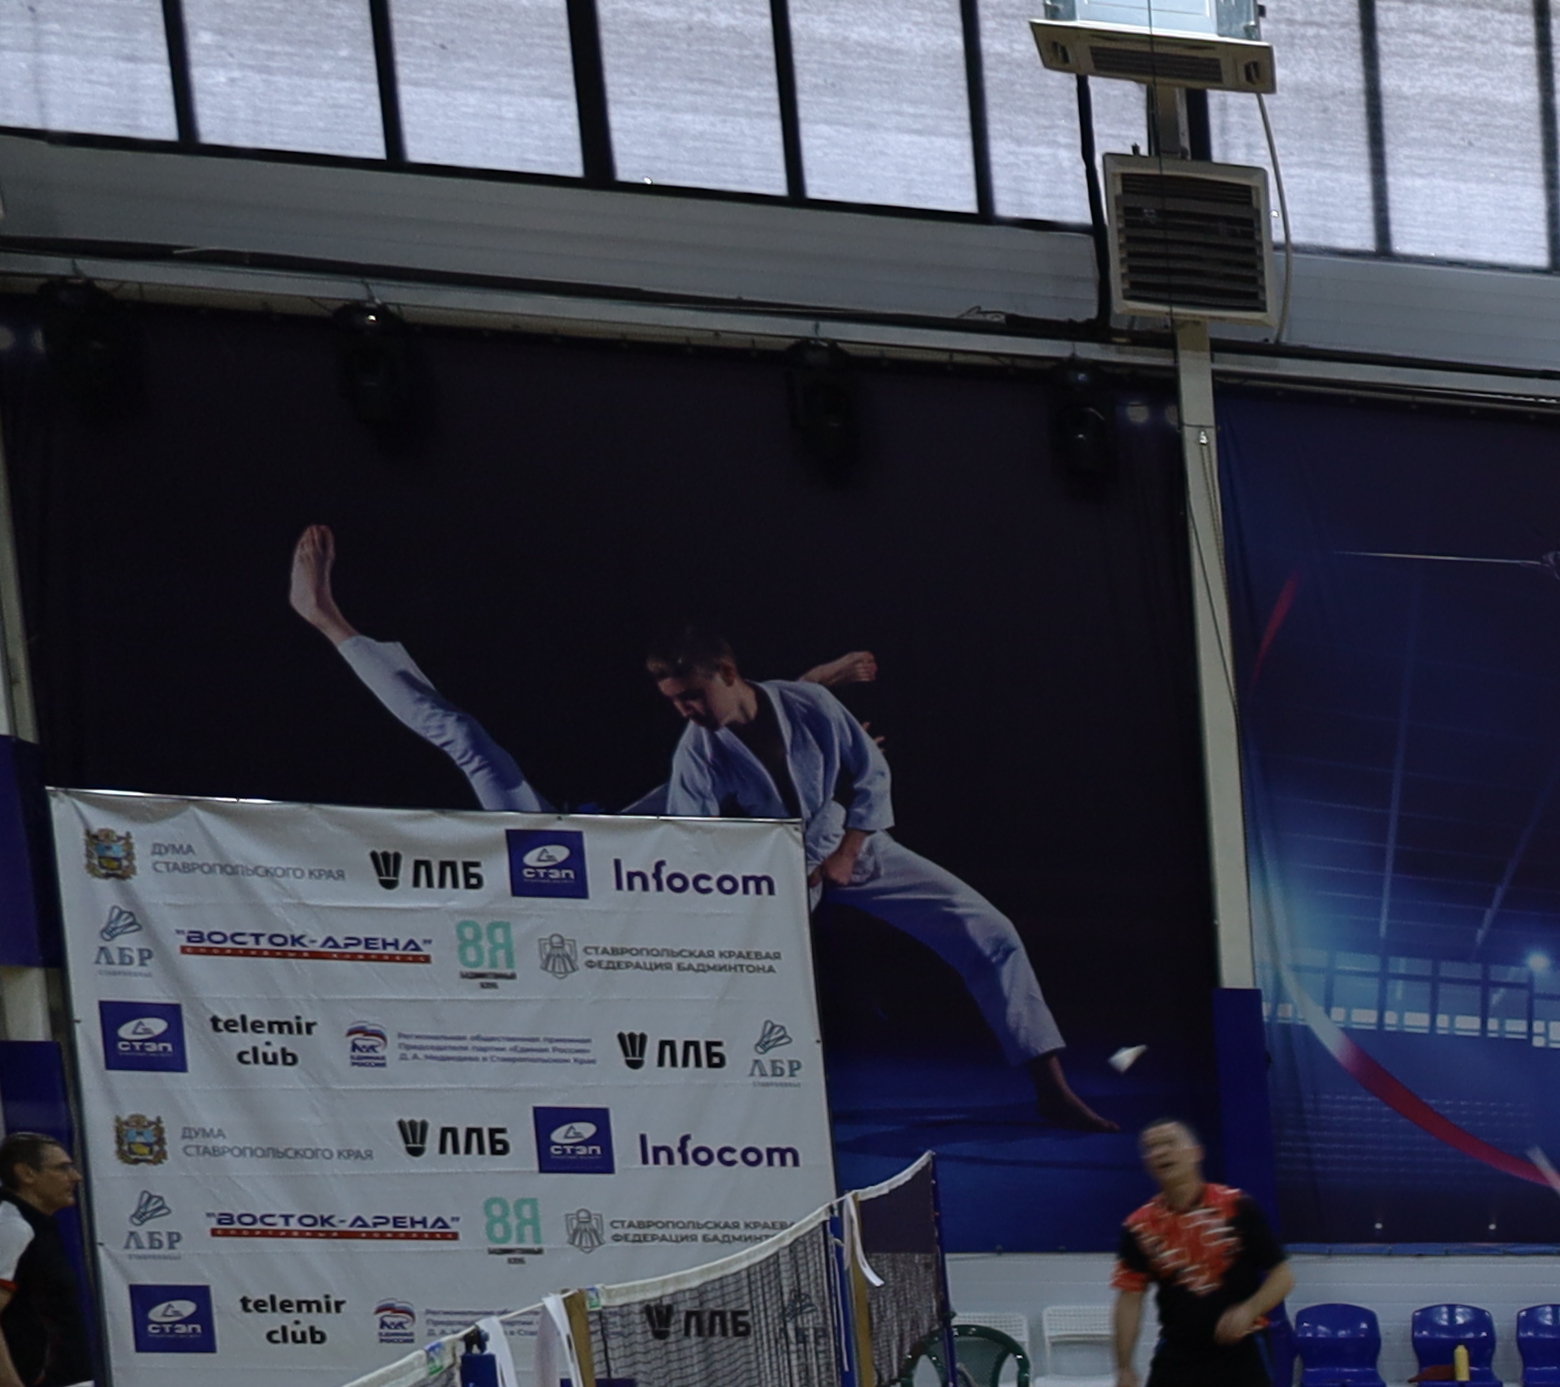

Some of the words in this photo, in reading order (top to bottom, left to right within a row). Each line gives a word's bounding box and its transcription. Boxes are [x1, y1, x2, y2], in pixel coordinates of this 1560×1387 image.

[151, 842, 195, 857] ДУМА
[152, 860, 305, 880] СТАВРОПОЛЬСКОГО
[308, 868, 346, 881] КРАЯ
[521, 866, 575, 880] СТЭП
[613, 858, 776, 897] Infocom
[175, 929, 433, 952] "ВОСТОК-АРЕНА"
[583, 945, 715, 960] СТАВРОПОЛЬСКАЯ
[717, 949, 782, 961] КРАЕВАЯ
[585, 960, 673, 972] ФЕДЕРАЦИЯ
[677, 962, 777, 974] БАДМИНТОНА
[210, 1014, 318, 1036] telemir
[117, 1040, 174, 1053] СТЭП
[237, 1047, 299, 1067] club
[181, 1126, 225, 1140] ДУМА
[182, 1144, 333, 1161] СТАВРОПОЛЬСКОГО
[337, 1149, 373, 1161] КРАЯ
[550, 1145, 602, 1155] СТЭП
[639, 1132, 800, 1168] Infocom
[205, 1211, 461, 1230] "ВОСТОК-АРЕНА"
[610, 1219, 741, 1231] СТАВРОПОЛЬСКАЯ
[611, 1232, 698, 1244] ФЕДЕРАЦИЯ
[240, 1294, 346, 1315] telemir
[147, 1323, 202, 1334] СТЭП
[266, 1325, 328, 1345] club
